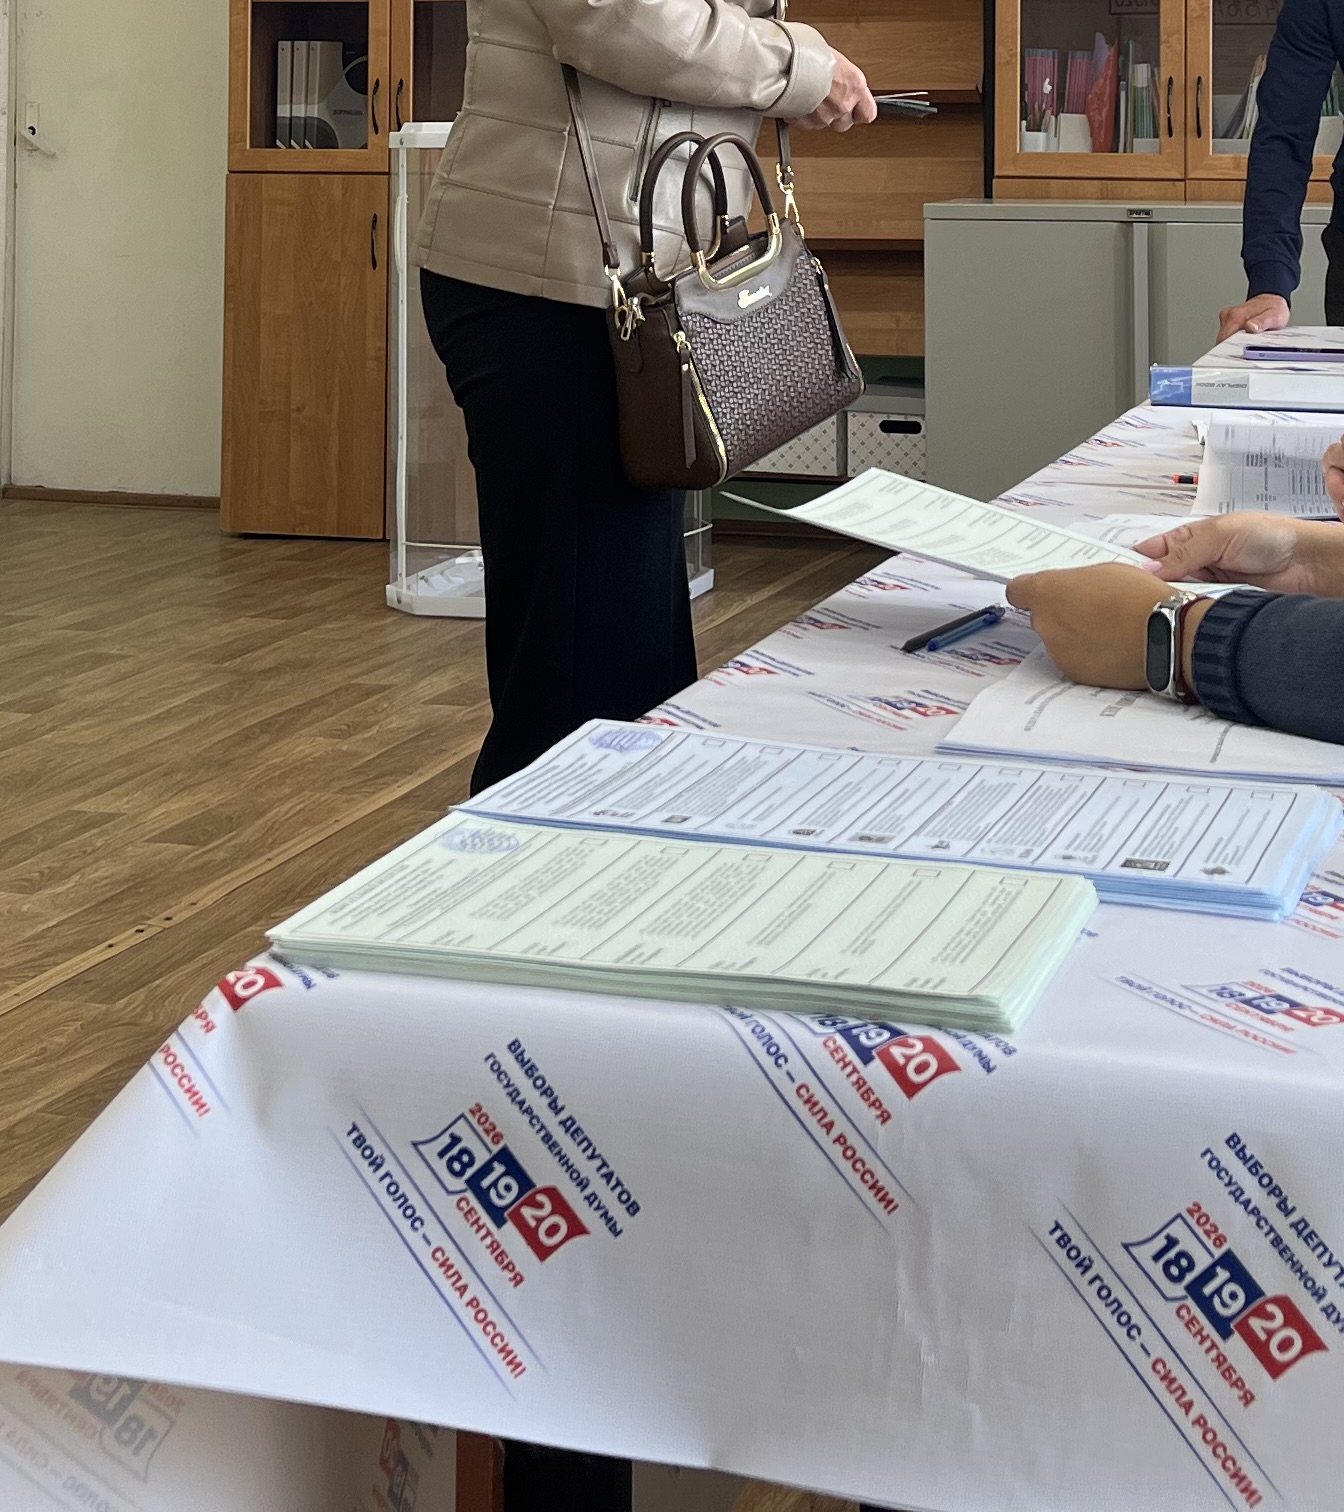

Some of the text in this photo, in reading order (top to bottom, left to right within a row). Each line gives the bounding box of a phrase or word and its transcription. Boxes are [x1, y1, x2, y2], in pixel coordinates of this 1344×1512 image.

[889, 1038, 938, 1084] 20
[1290, 1008, 1340, 1024] 20
[468, 1101, 506, 1147] 2026
[506, 1037, 641, 1218] ВЫБОРЫ ДЕПУТАТОВ
[822, 1036, 893, 1126] СЕНТЯБРЯ
[436, 1131, 570, 1248] 18 19 20
[484, 1052, 624, 1239] ГОСУДАРСТВЕННОЙ ДУМЫ
[795, 1082, 836, 1137] СИЛА
[833, 1131, 900, 1216] РОССИИ!
[1224, 1132, 1297, 1219] ВЫБОРЫ
[346, 1121, 387, 1178] ТВОЙ
[379, 1167, 425, 1233] ГОЛОС
[431, 1245, 470, 1300] СИЛА
[464, 1295, 527, 1379] РОССИИ!
[455, 1196, 525, 1289] СЕНТЯБРЯ
[1186, 1201, 1228, 1250] 2026
[1200, 1147, 1327, 1305] ГОСУДАРСТВЕННОЙ
[1151, 1233, 1303, 1363] 18 19 20
[1048, 1220, 1095, 1278] ТВОЙ
[1088, 1273, 1142, 1343] ГОЛОС
[1151, 1357, 1196, 1417] СИЛА
[1191, 1413, 1263, 1509] РОССИИ!
[1175, 1303, 1256, 1408] СЕНТЯБРЯ
